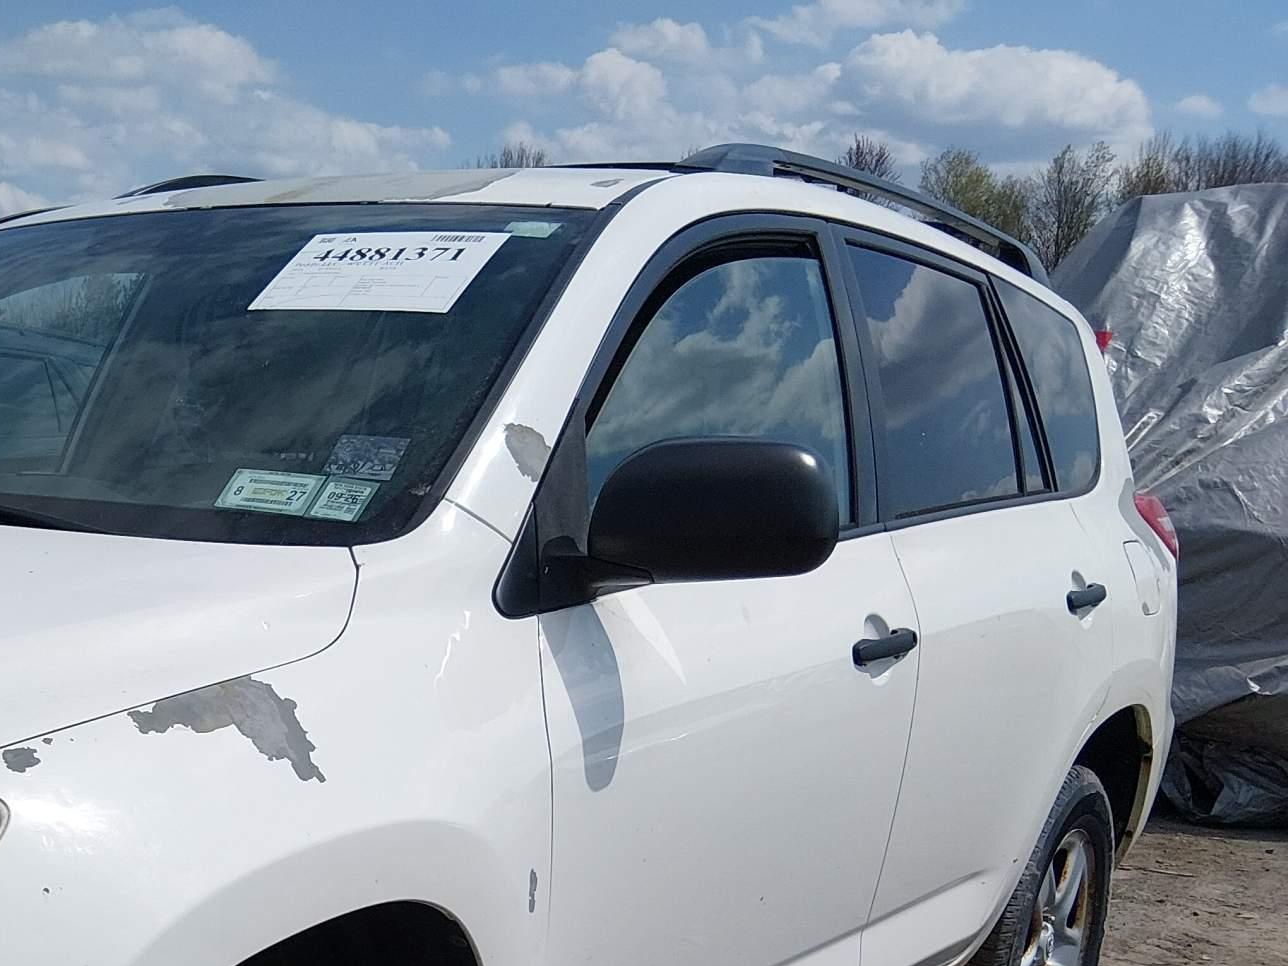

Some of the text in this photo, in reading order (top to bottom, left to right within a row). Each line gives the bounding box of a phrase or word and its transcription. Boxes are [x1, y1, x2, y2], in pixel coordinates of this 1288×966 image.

[313, 247, 467, 262] 44881371
[233, 486, 243, 496] 8
[286, 490, 307, 502] 27
